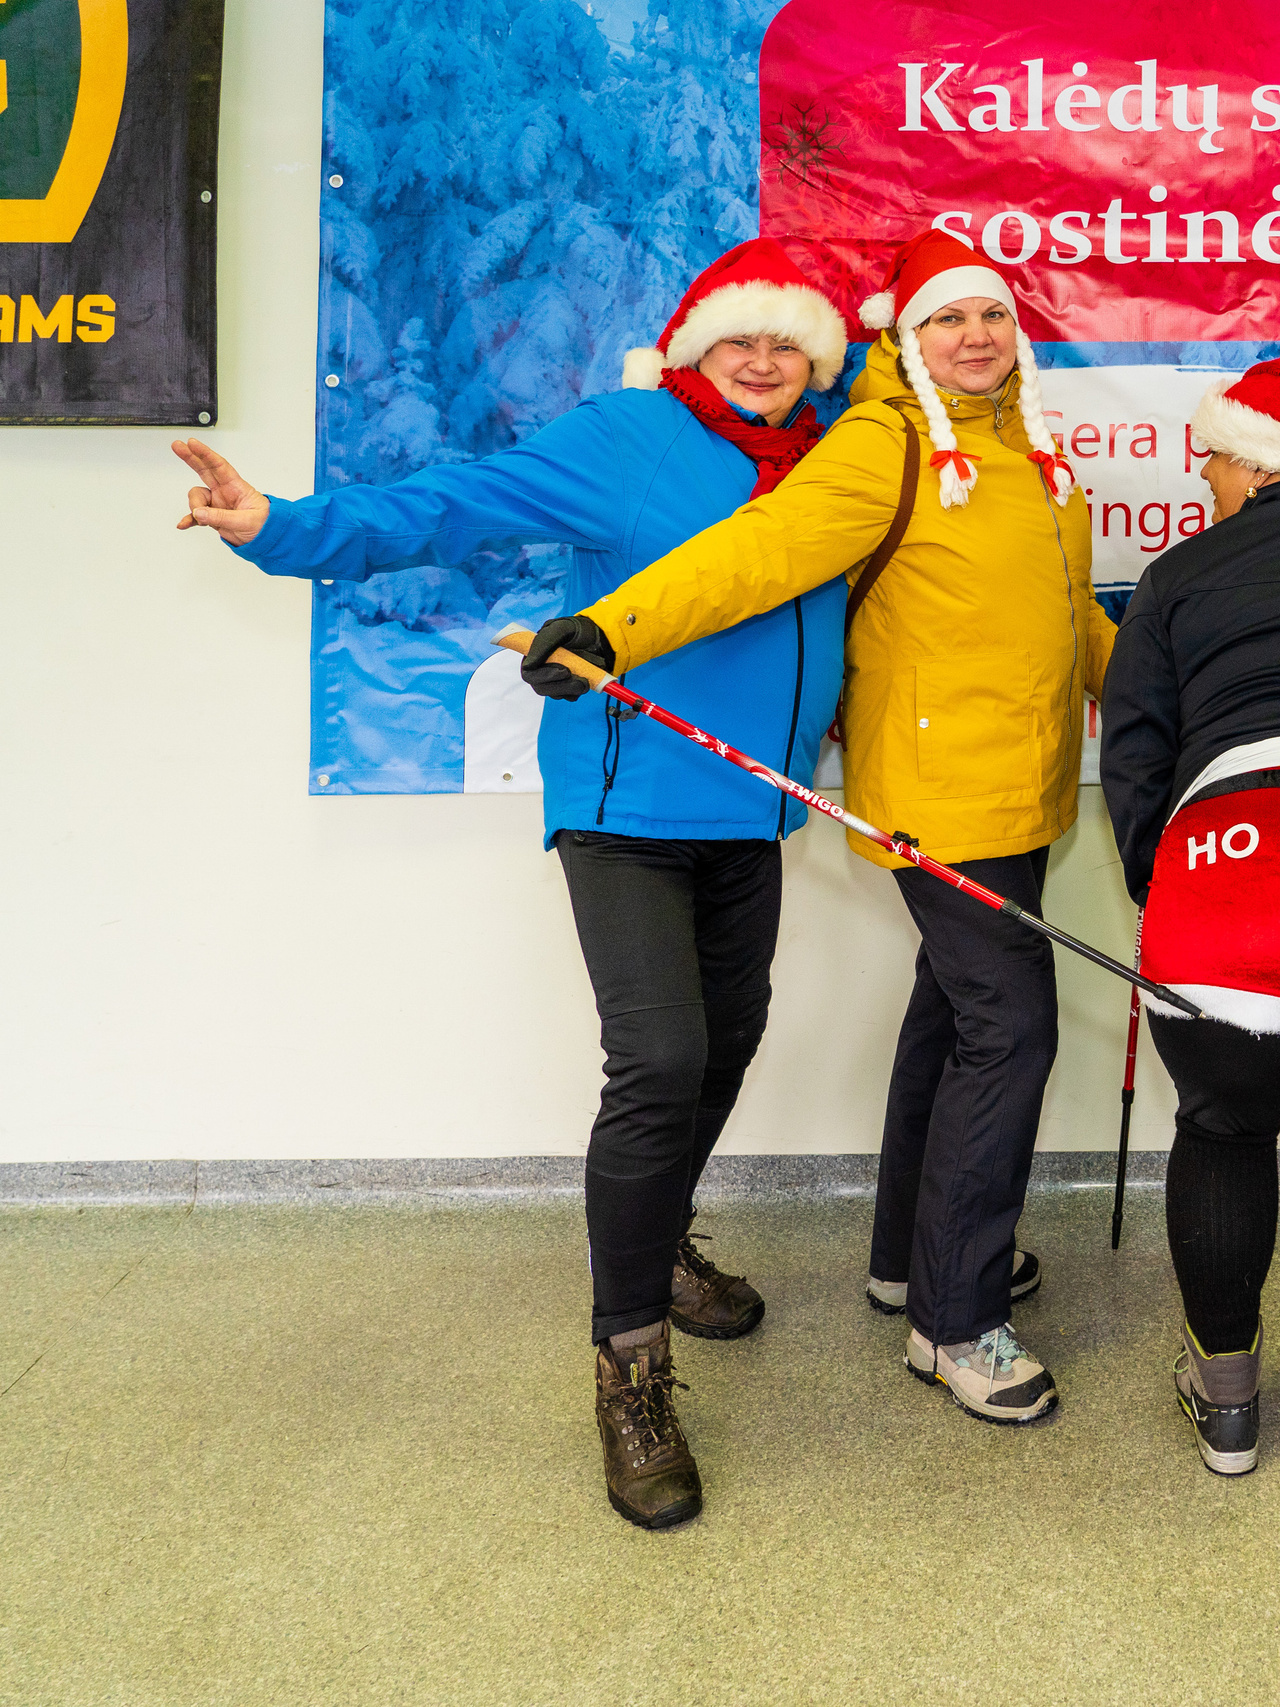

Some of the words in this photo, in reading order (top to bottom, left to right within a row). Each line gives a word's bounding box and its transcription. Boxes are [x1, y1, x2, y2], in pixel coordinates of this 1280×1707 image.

[898, 58, 1224, 153] Kalėdų
[1041, 410, 1157, 459] Gera
[788, 780, 844, 817] TWIGO
[1188, 823, 1260, 870] HO
